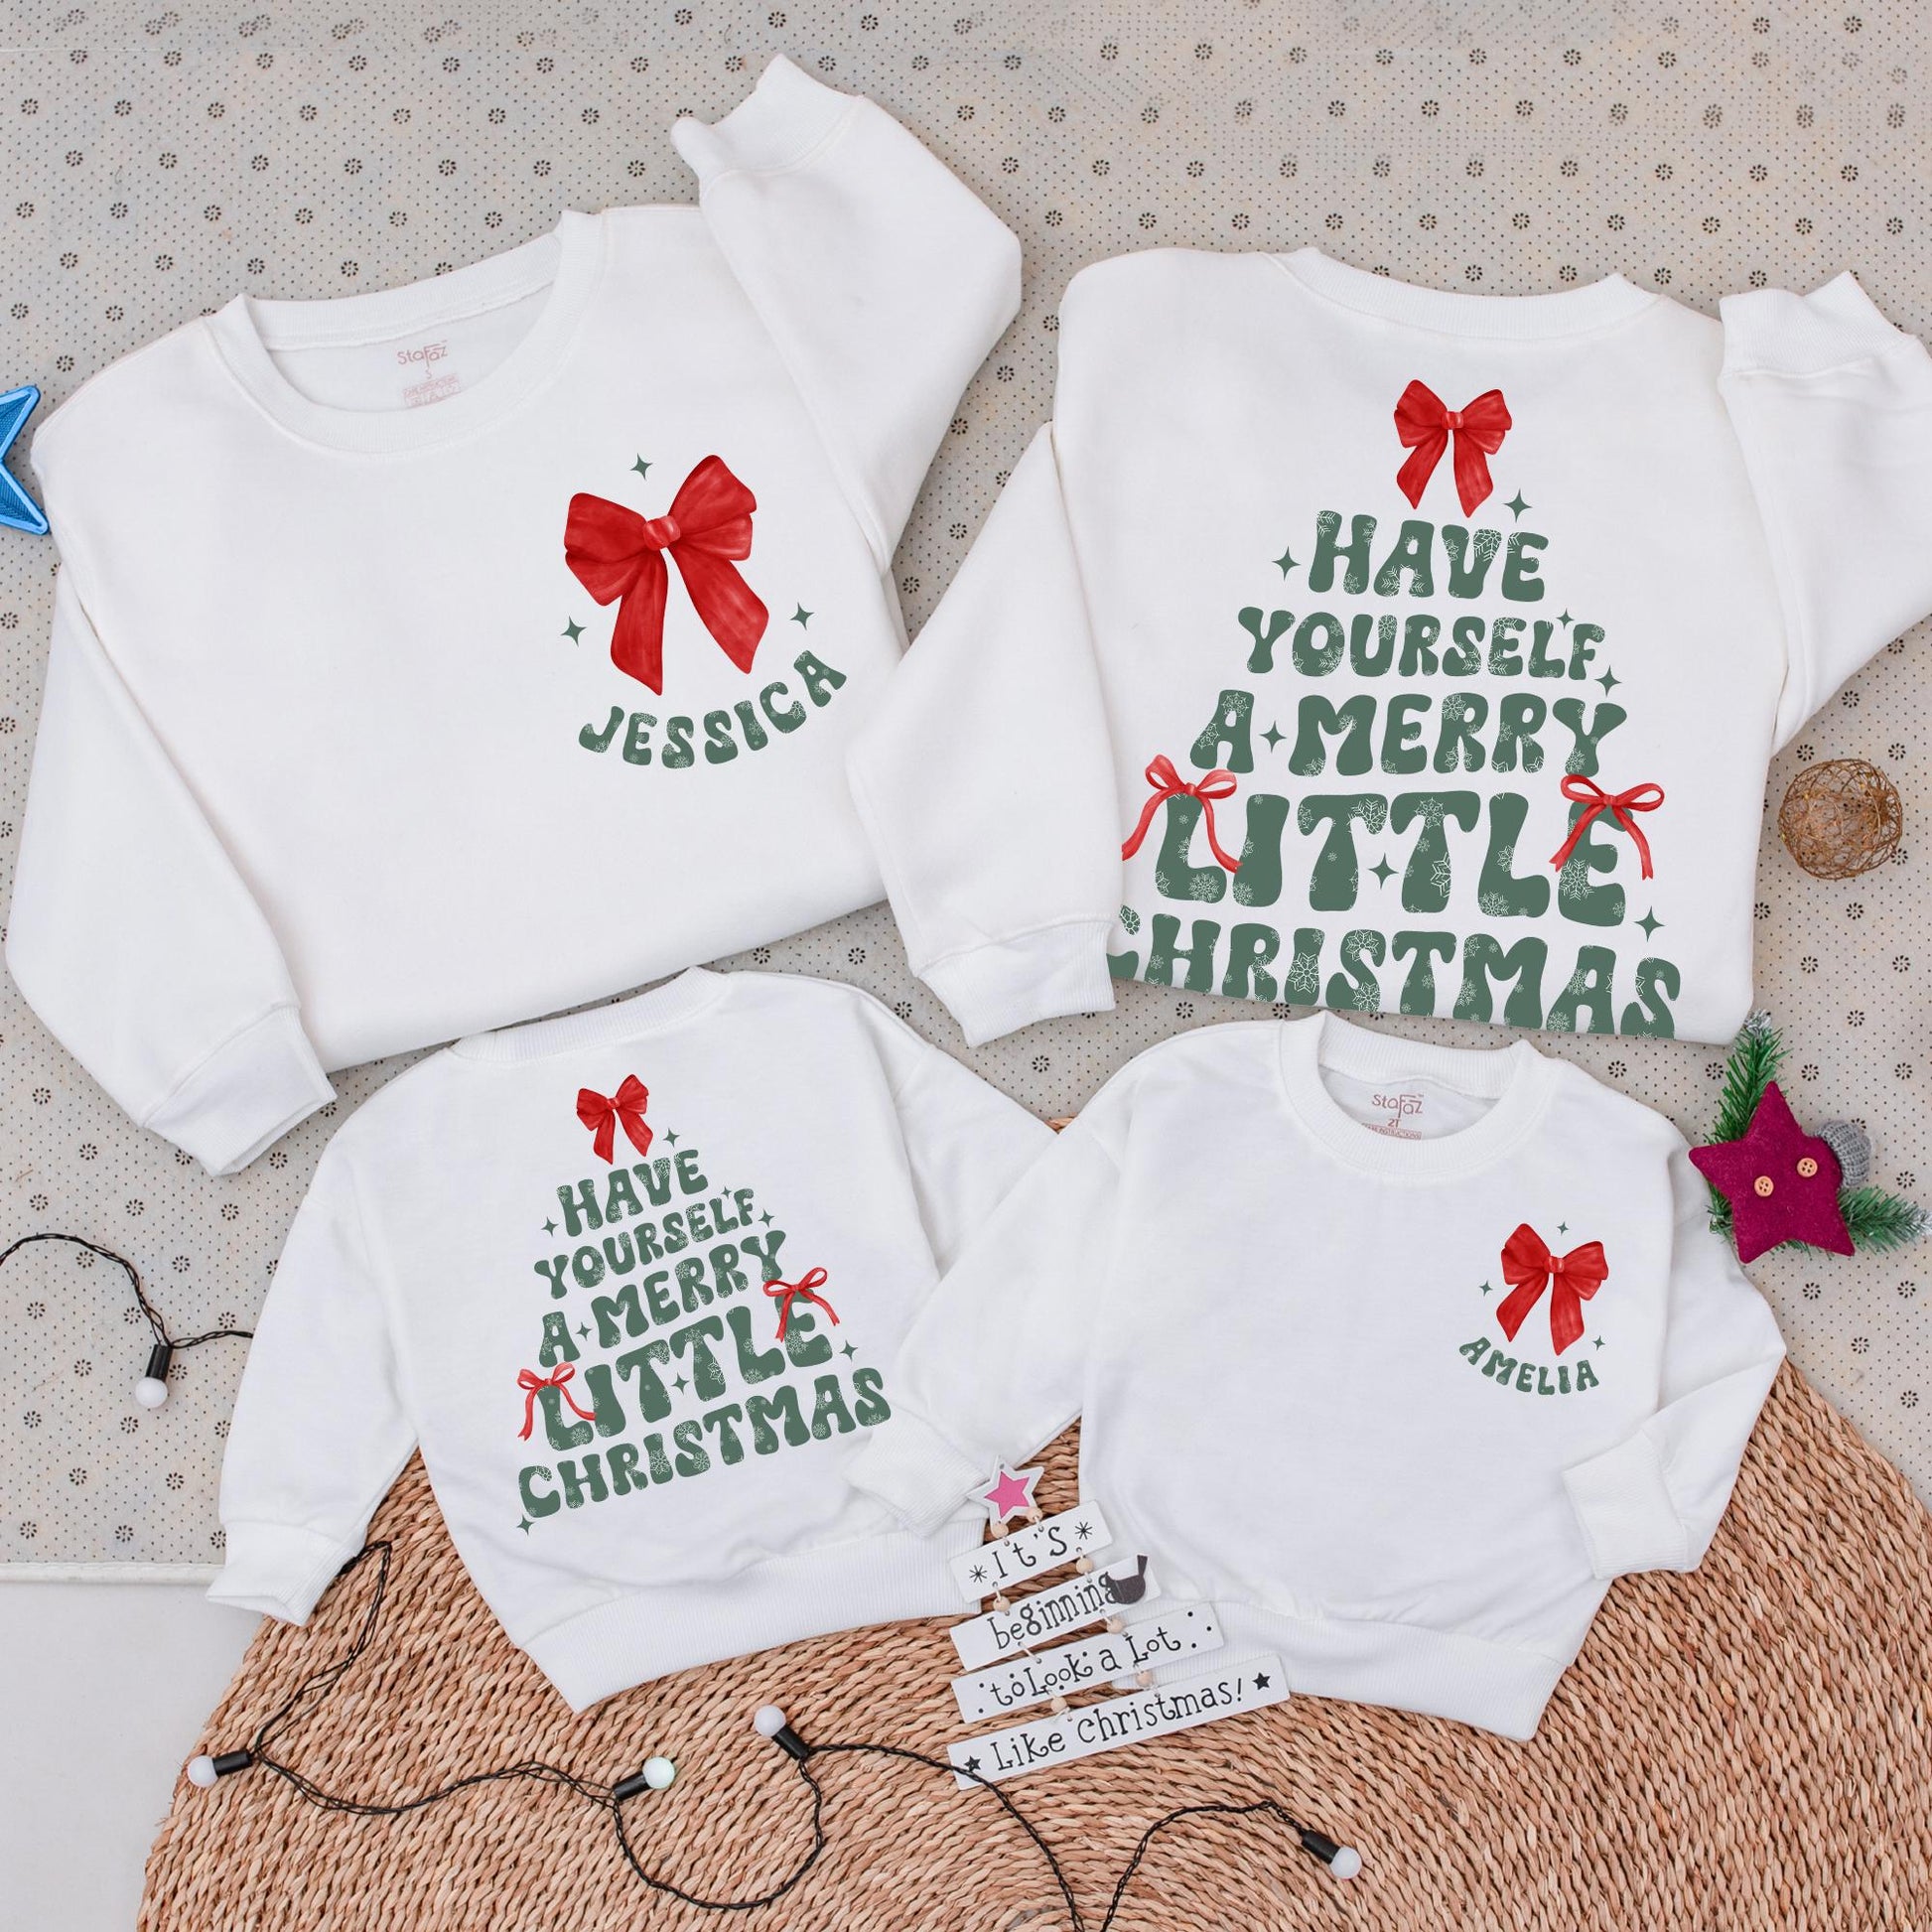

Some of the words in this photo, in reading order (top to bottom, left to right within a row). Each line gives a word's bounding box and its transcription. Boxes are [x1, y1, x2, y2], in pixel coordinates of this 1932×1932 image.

[1309, 510, 1549, 602] HAVE
[1238, 607, 1605, 680] YOURSELF
[578, 650, 847, 768] JESSICA
[1190, 689, 1255, 774] A
[1289, 692, 1627, 777] MERRY
[1155, 790, 1634, 927] LITTLE
[1387, 1118, 1401, 1128] 2T
[556, 1149, 708, 1236] HAVE
[534, 1188, 754, 1299] YOURSELF
[538, 1311, 580, 1367] A
[591, 1230, 786, 1348] MERRY
[537, 1289, 832, 1450] LITTLE
[1459, 1336, 1599, 1395] AMELIA
[518, 1367, 892, 1518] CHRISTMAS
[1098, 1648, 1122, 1672] a
[990, 1732, 1065, 1771] Like
